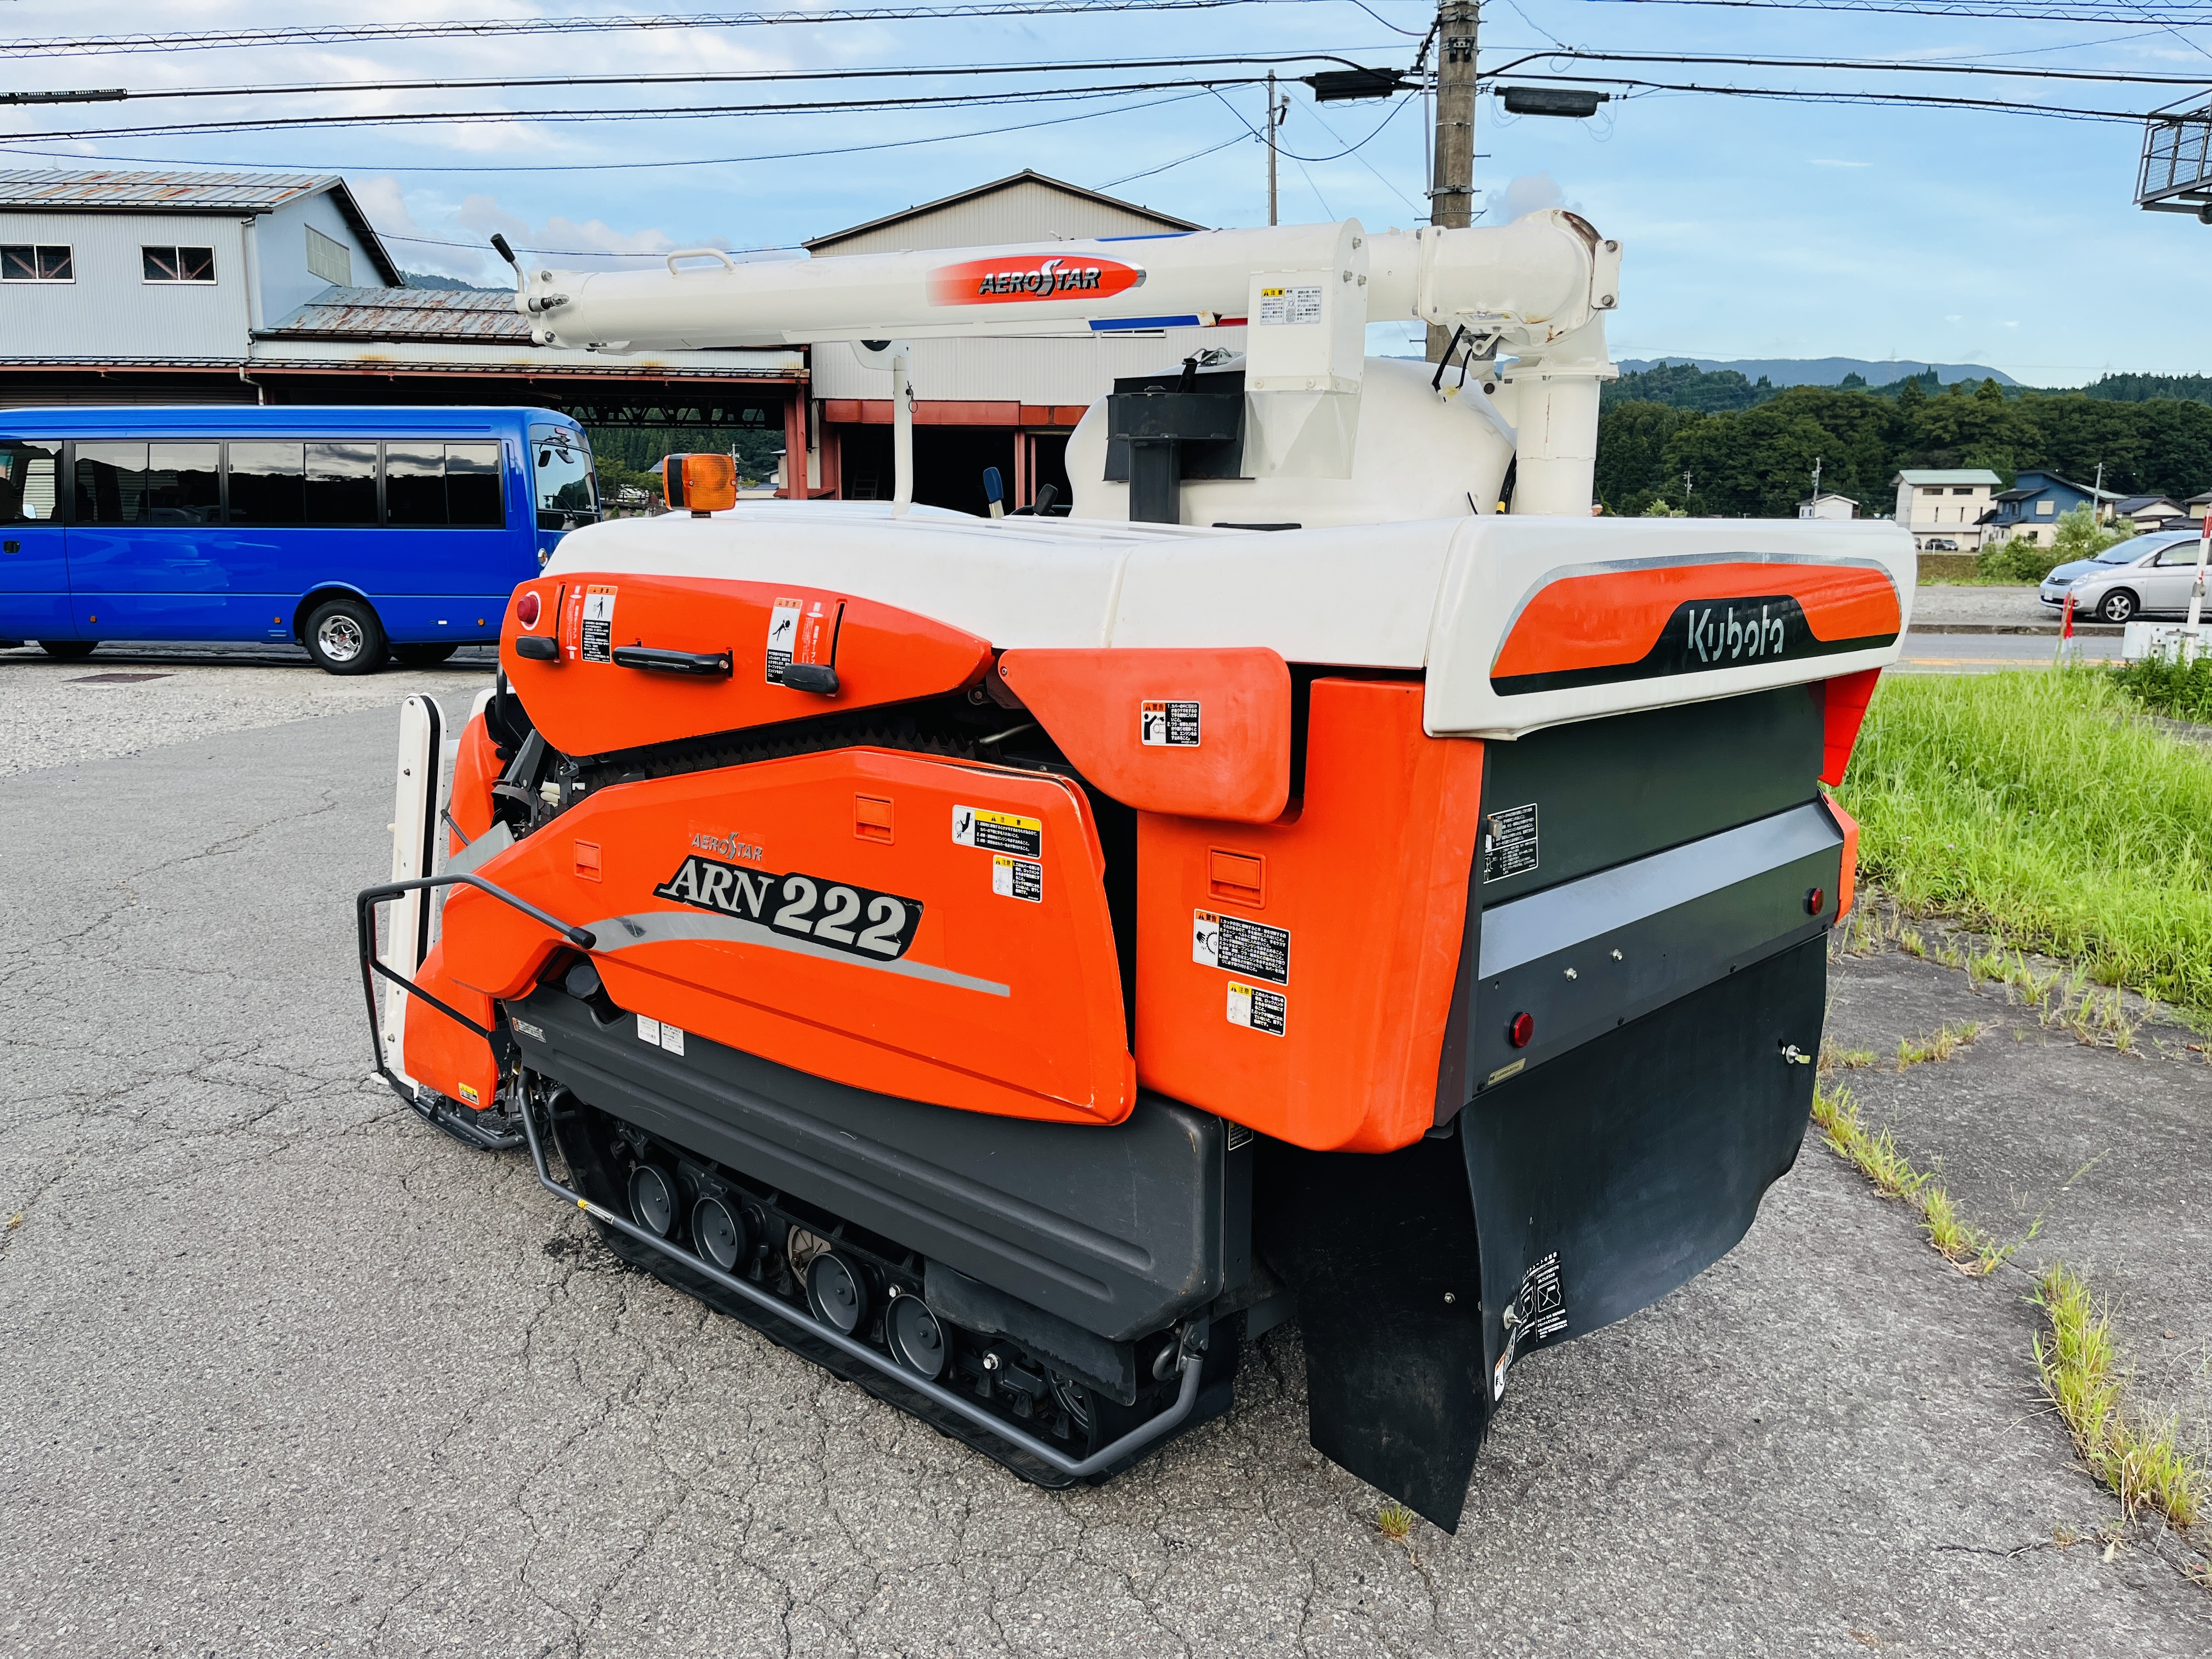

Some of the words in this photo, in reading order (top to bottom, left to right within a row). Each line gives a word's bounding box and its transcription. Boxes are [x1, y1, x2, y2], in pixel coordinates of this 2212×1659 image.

[978, 259, 1102, 297] AEROSTAR
[1688, 605, 1784, 662] Kubota
[692, 832, 763, 862] AEROSTAR
[658, 859, 775, 918] ARN
[773, 876, 906, 956] 222
